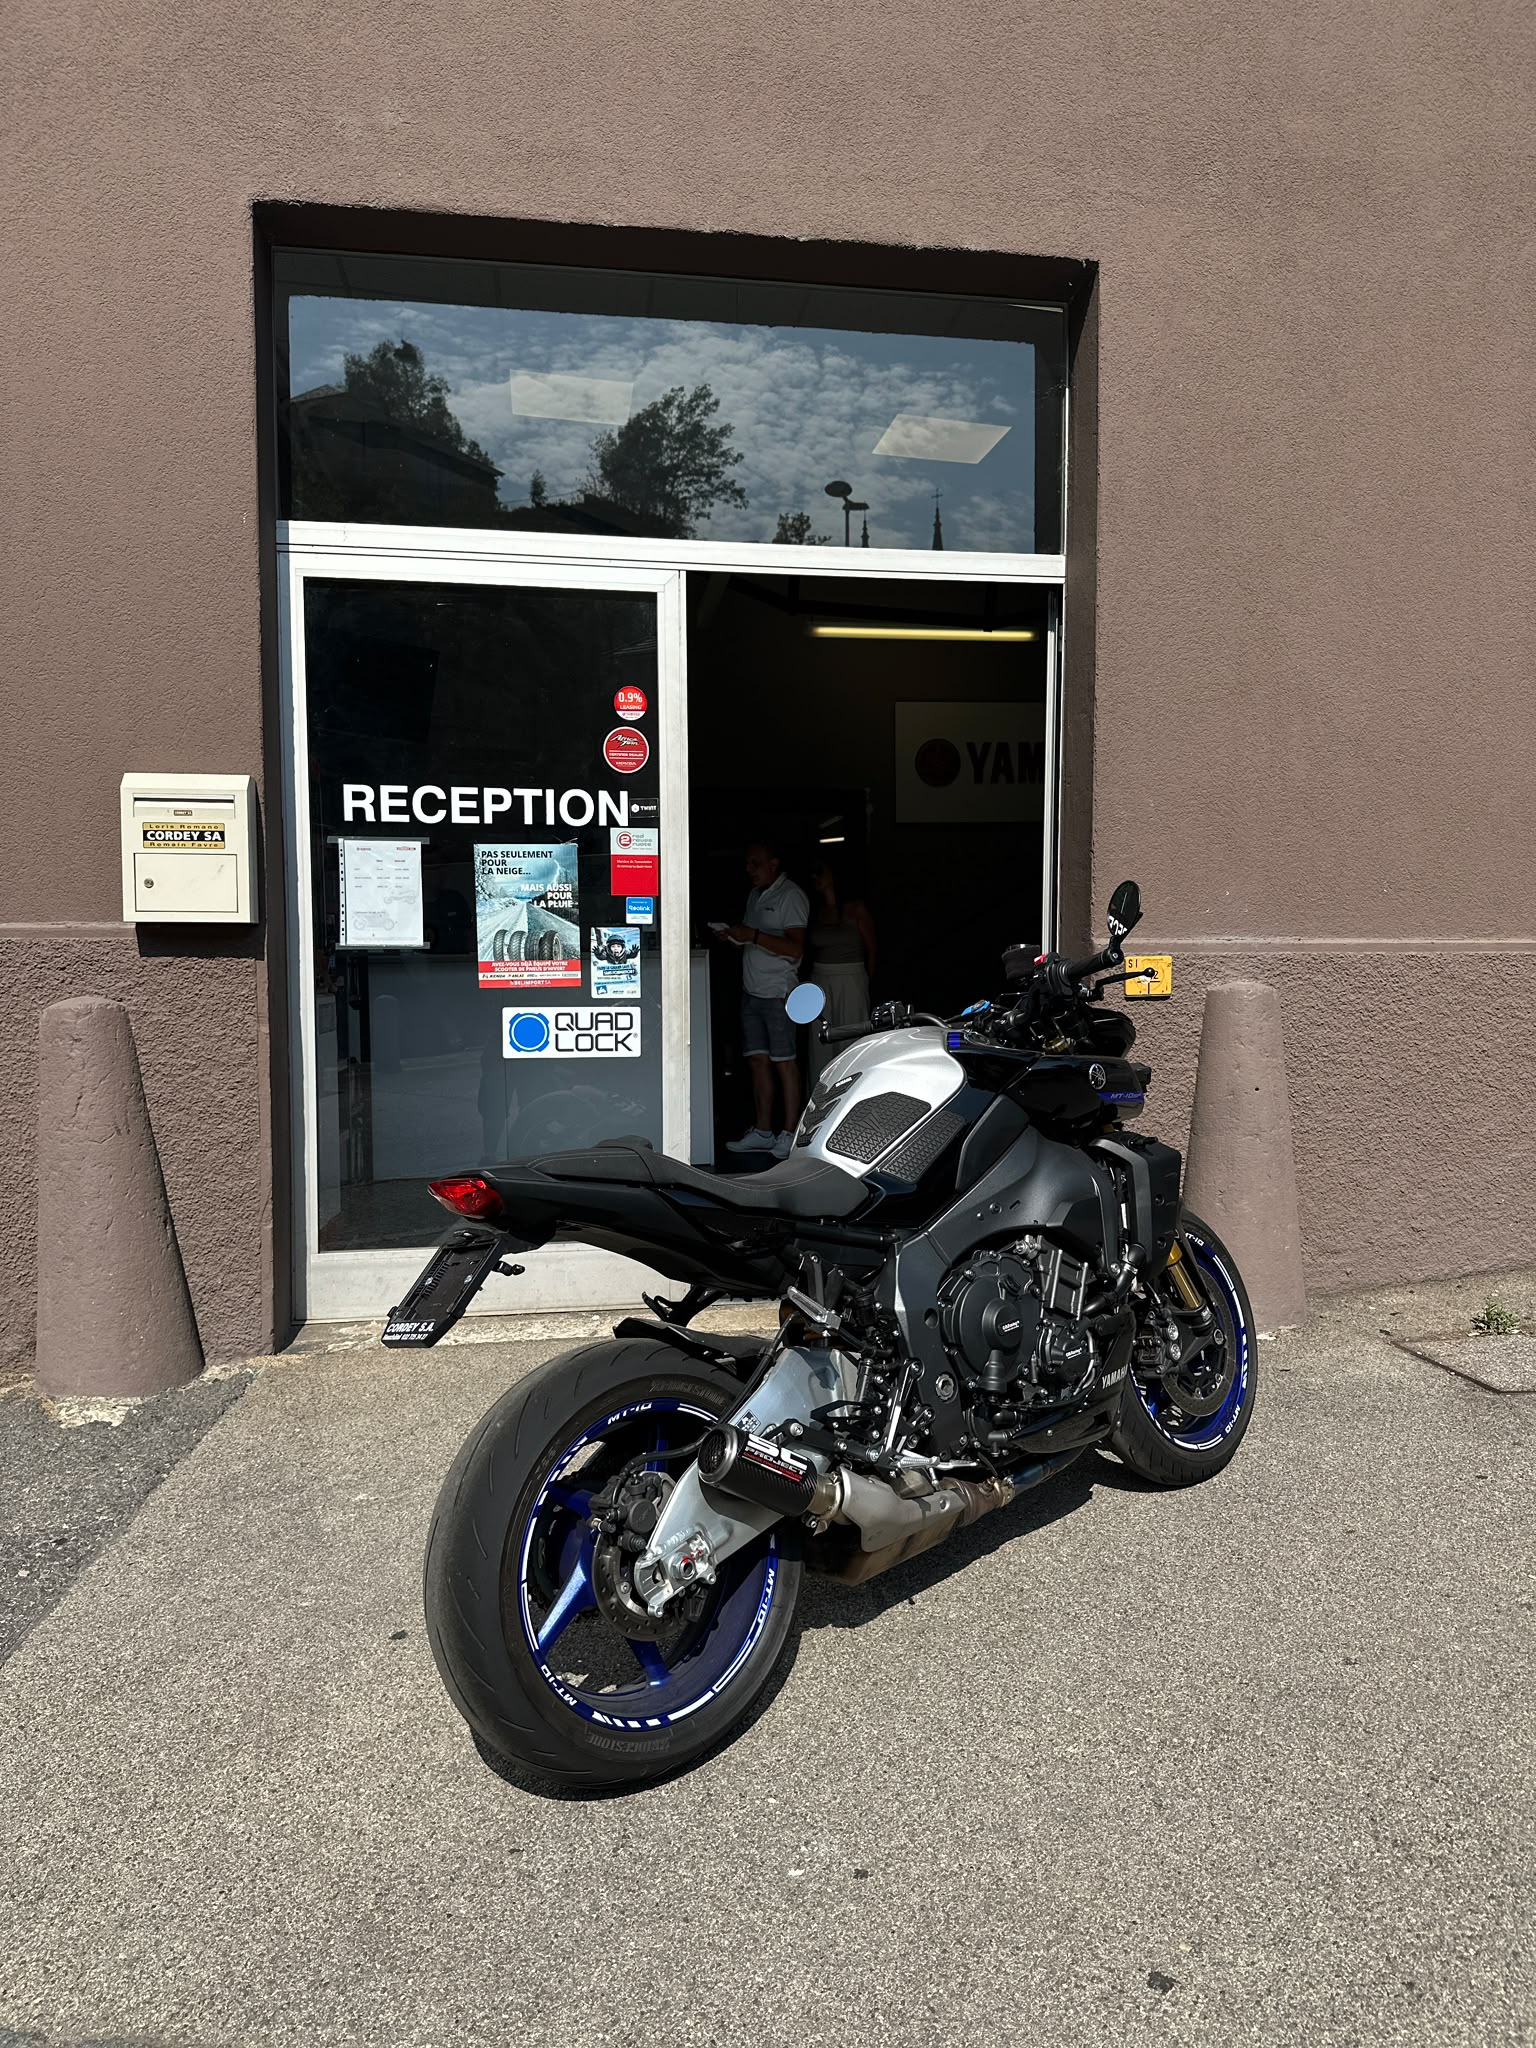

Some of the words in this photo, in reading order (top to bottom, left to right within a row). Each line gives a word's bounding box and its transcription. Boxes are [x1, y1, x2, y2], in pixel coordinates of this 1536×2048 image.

[618, 692, 643, 703] 0.9%
[342, 783, 629, 827] RECEPTION
[146, 830, 200, 841] CORDEY
[203, 831, 222, 841] SA
[481, 850, 499, 858] PAS
[500, 850, 554, 859] SEULEMENT
[481, 859, 508, 867] POUR
[482, 867, 494, 875] LA
[546, 883, 572, 892] AUSSI
[547, 892, 573, 900] POUR
[555, 1012, 634, 1031] QUAD
[386, 1322, 421, 1333] CORDEY
[648, 1379, 725, 1406] BRIDGESTONE
[607, 1402, 653, 1425] MT-10
[744, 1446, 806, 1476] PROJECT
[746, 1433, 808, 1471] SC
[757, 1567, 775, 1624] MT-10
[540, 1664, 578, 1707] MT-10
[584, 1732, 671, 1753] BRIDGESTONE
